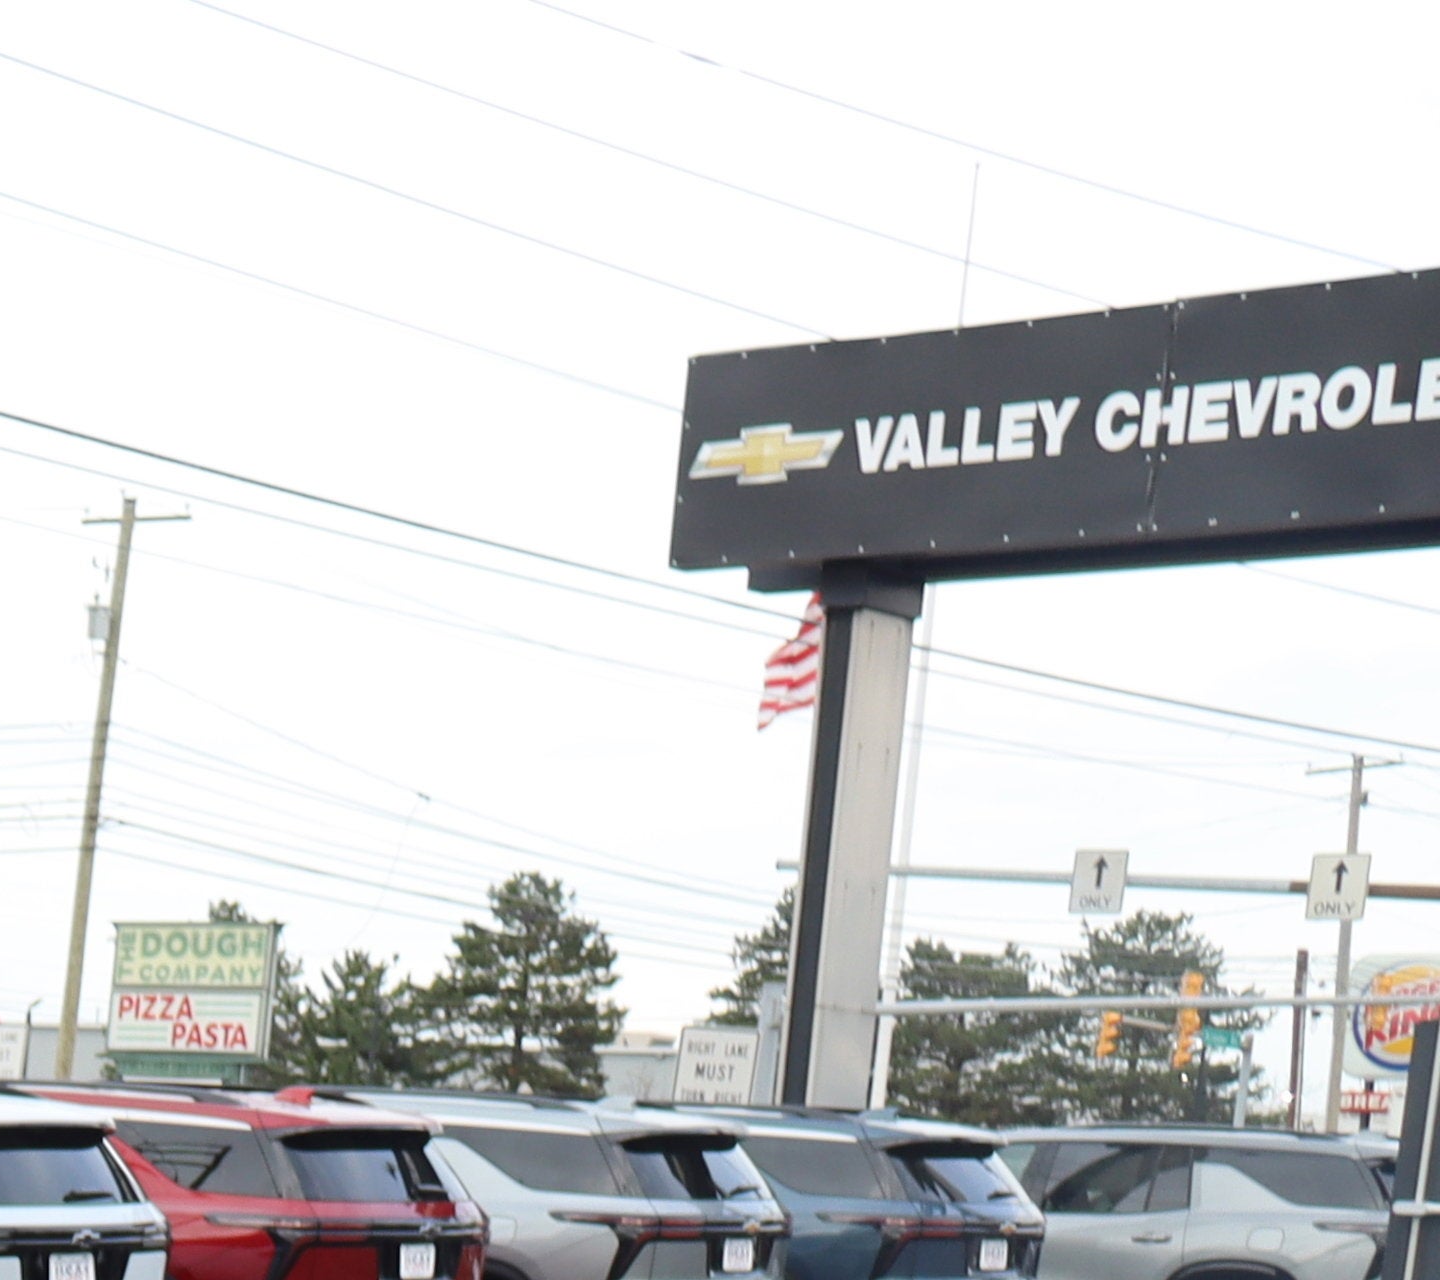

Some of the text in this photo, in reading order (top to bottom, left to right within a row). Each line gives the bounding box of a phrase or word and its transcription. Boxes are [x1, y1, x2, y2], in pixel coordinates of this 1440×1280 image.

[855, 395, 1081, 475] VALLEY
[1313, 900, 1354, 916] ONLY
[140, 928, 264, 958] DOUGH
[139, 964, 263, 983] COMPANY
[118, 993, 194, 1020] PIZZA
[171, 1023, 248, 1049] PASTA
[694, 1062, 735, 1081] MUST
